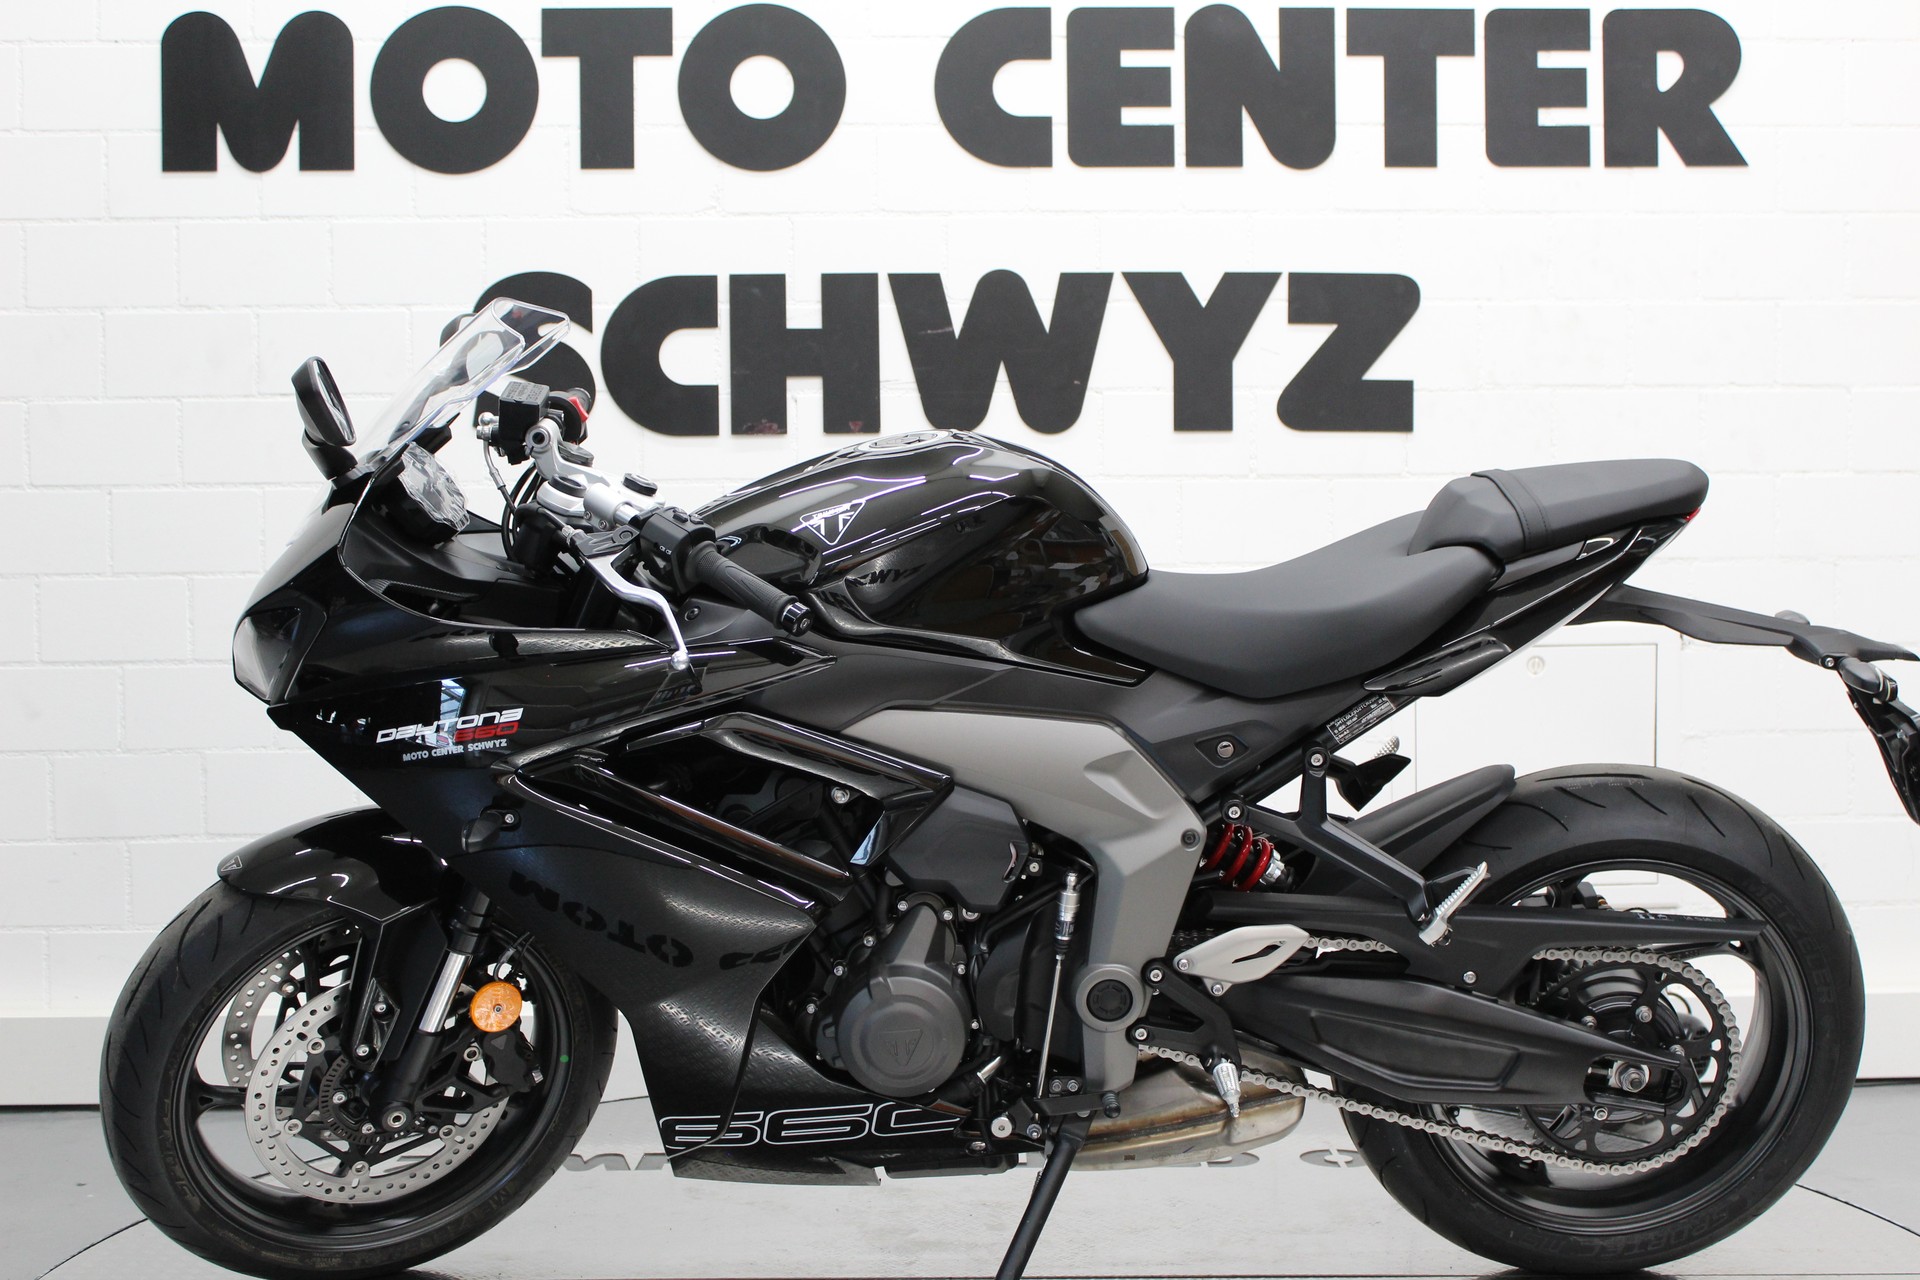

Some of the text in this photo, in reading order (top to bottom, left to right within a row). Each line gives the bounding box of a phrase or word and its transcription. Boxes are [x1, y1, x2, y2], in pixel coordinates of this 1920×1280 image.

[161, 3, 1750, 174] MOTO CENTER
[472, 269, 1421, 436] SCHWYZ
[402, 738, 508, 762] MOTO CENTER SCHWYZ
[454, 721, 520, 742] 660
